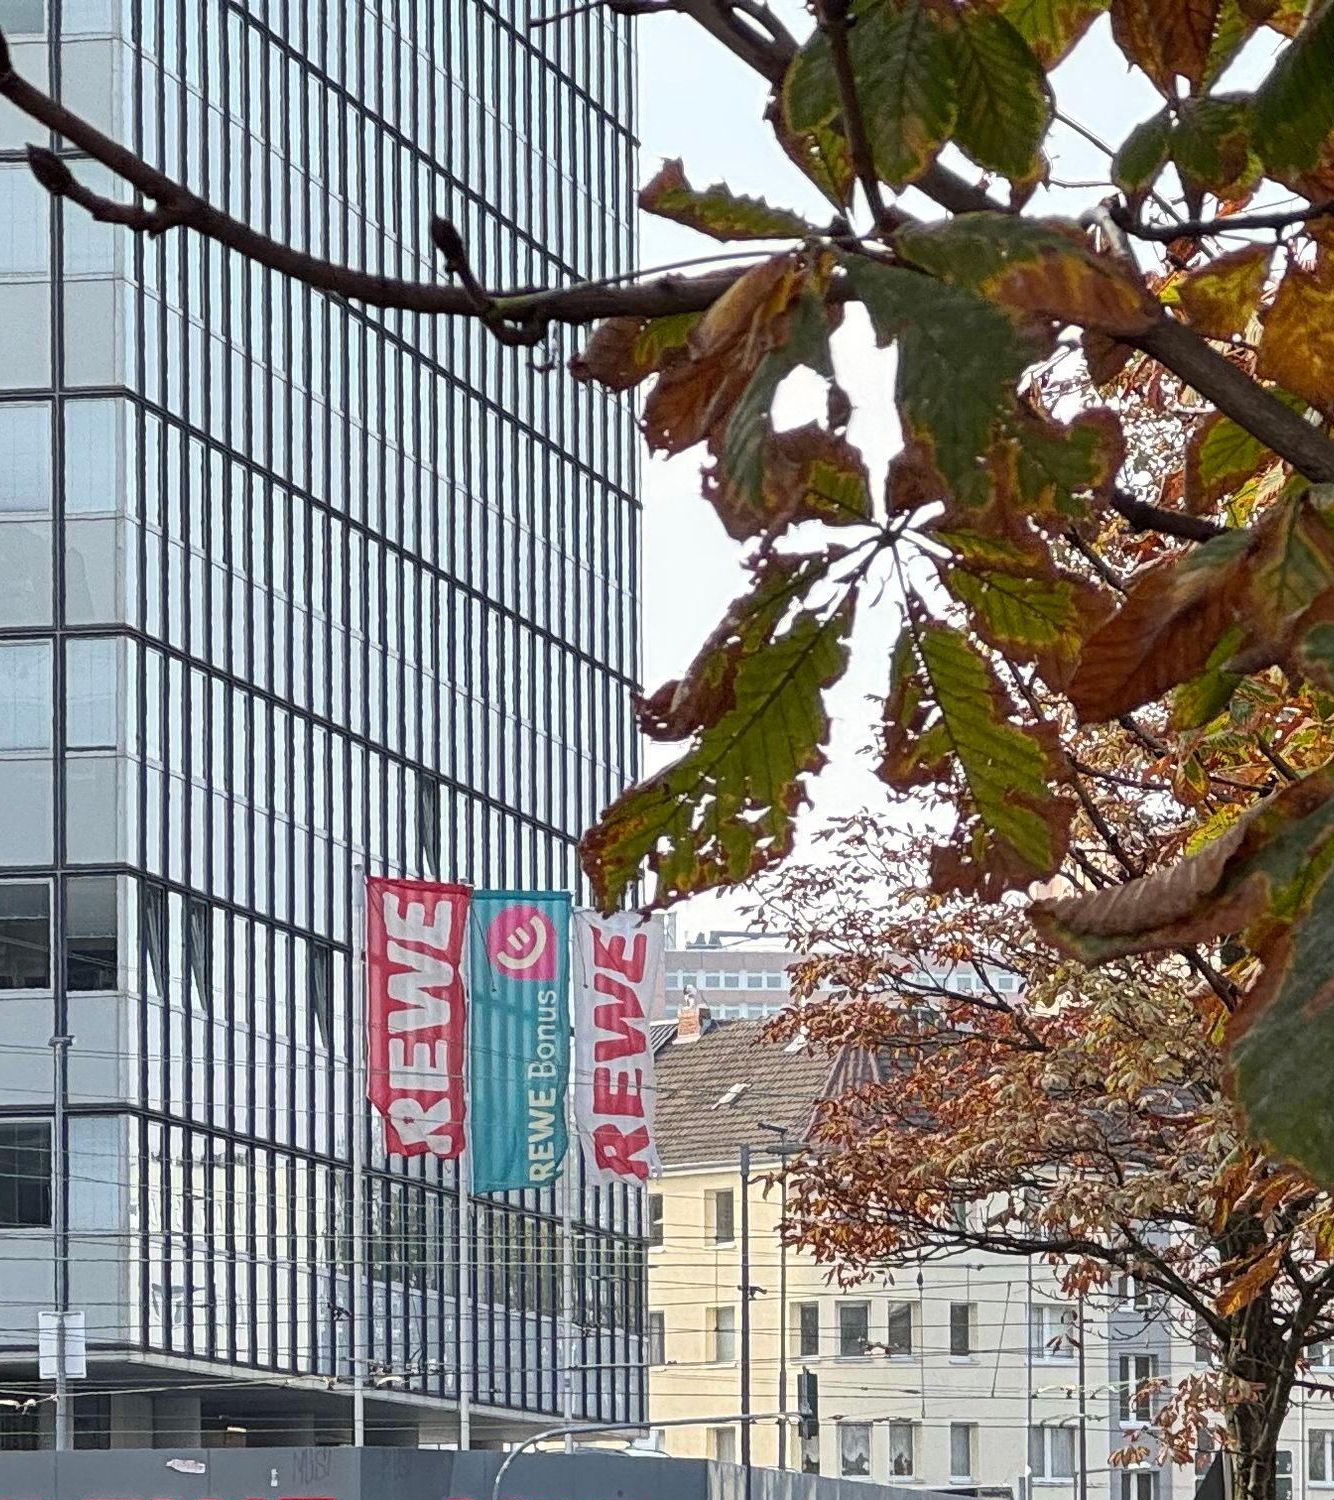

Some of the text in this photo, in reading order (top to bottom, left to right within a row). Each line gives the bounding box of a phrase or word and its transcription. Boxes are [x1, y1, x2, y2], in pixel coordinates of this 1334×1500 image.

[383, 891, 454, 1156] REWE
[528, 990, 562, 1182] REWE Bonus
[589, 923, 650, 1181] REWE
